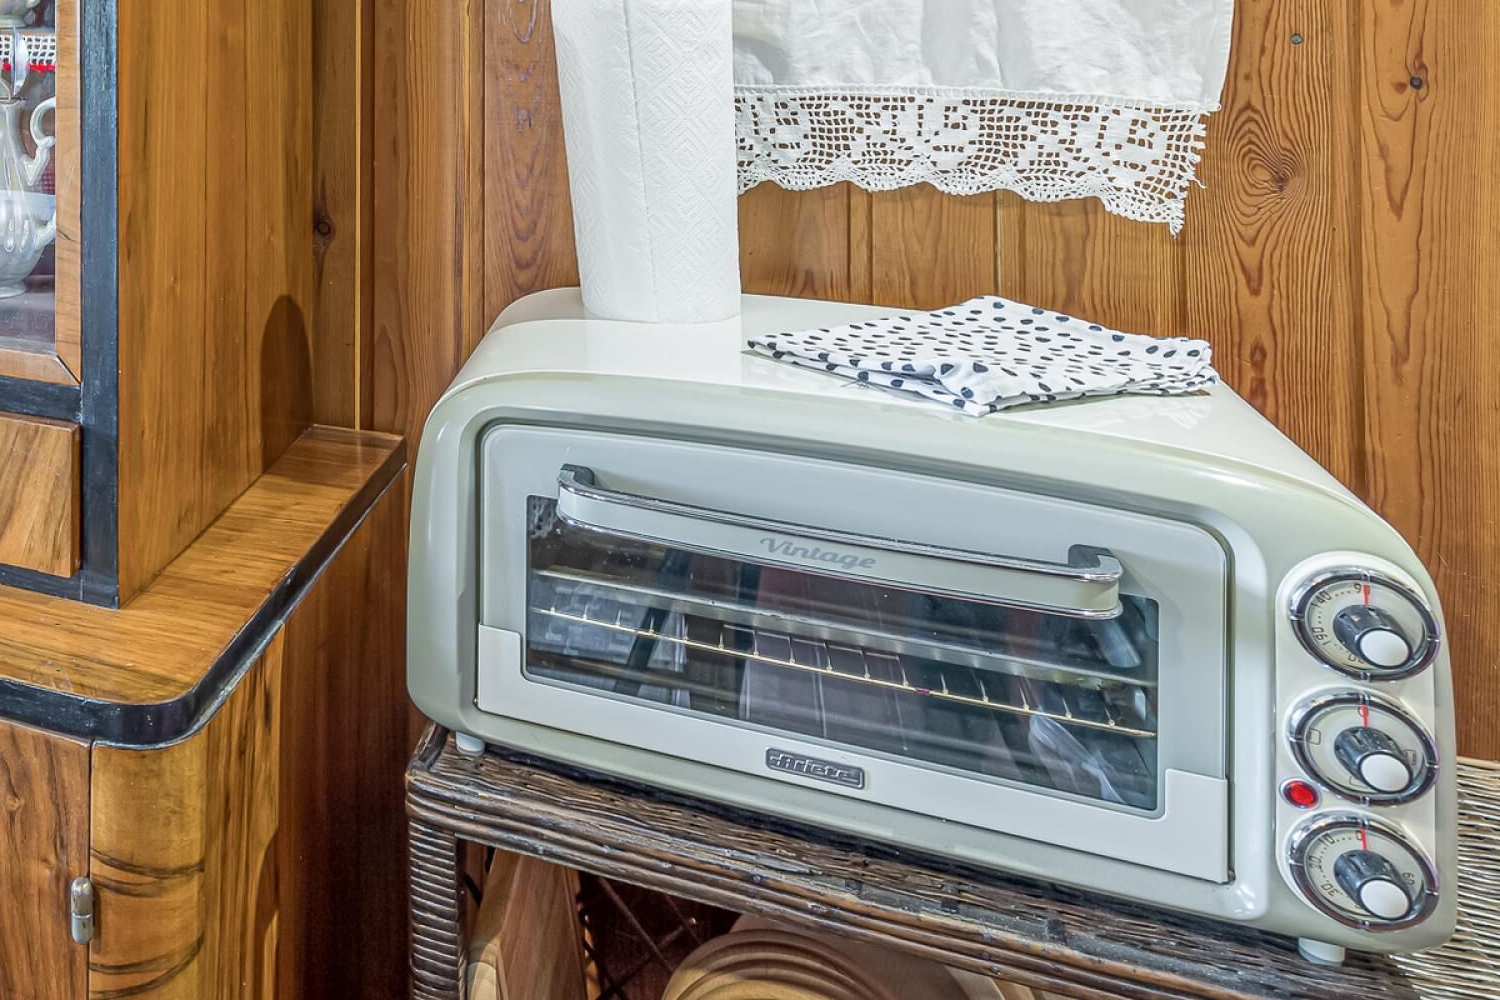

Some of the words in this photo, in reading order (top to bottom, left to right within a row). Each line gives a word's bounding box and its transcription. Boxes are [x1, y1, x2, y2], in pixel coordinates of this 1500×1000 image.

[760, 538, 877, 570] Vintage
[1310, 590, 1332, 607] 140
[1311, 626, 1331, 646] 190
[1318, 832, 1336, 848] 10
[1321, 882, 1339, 897] 30
